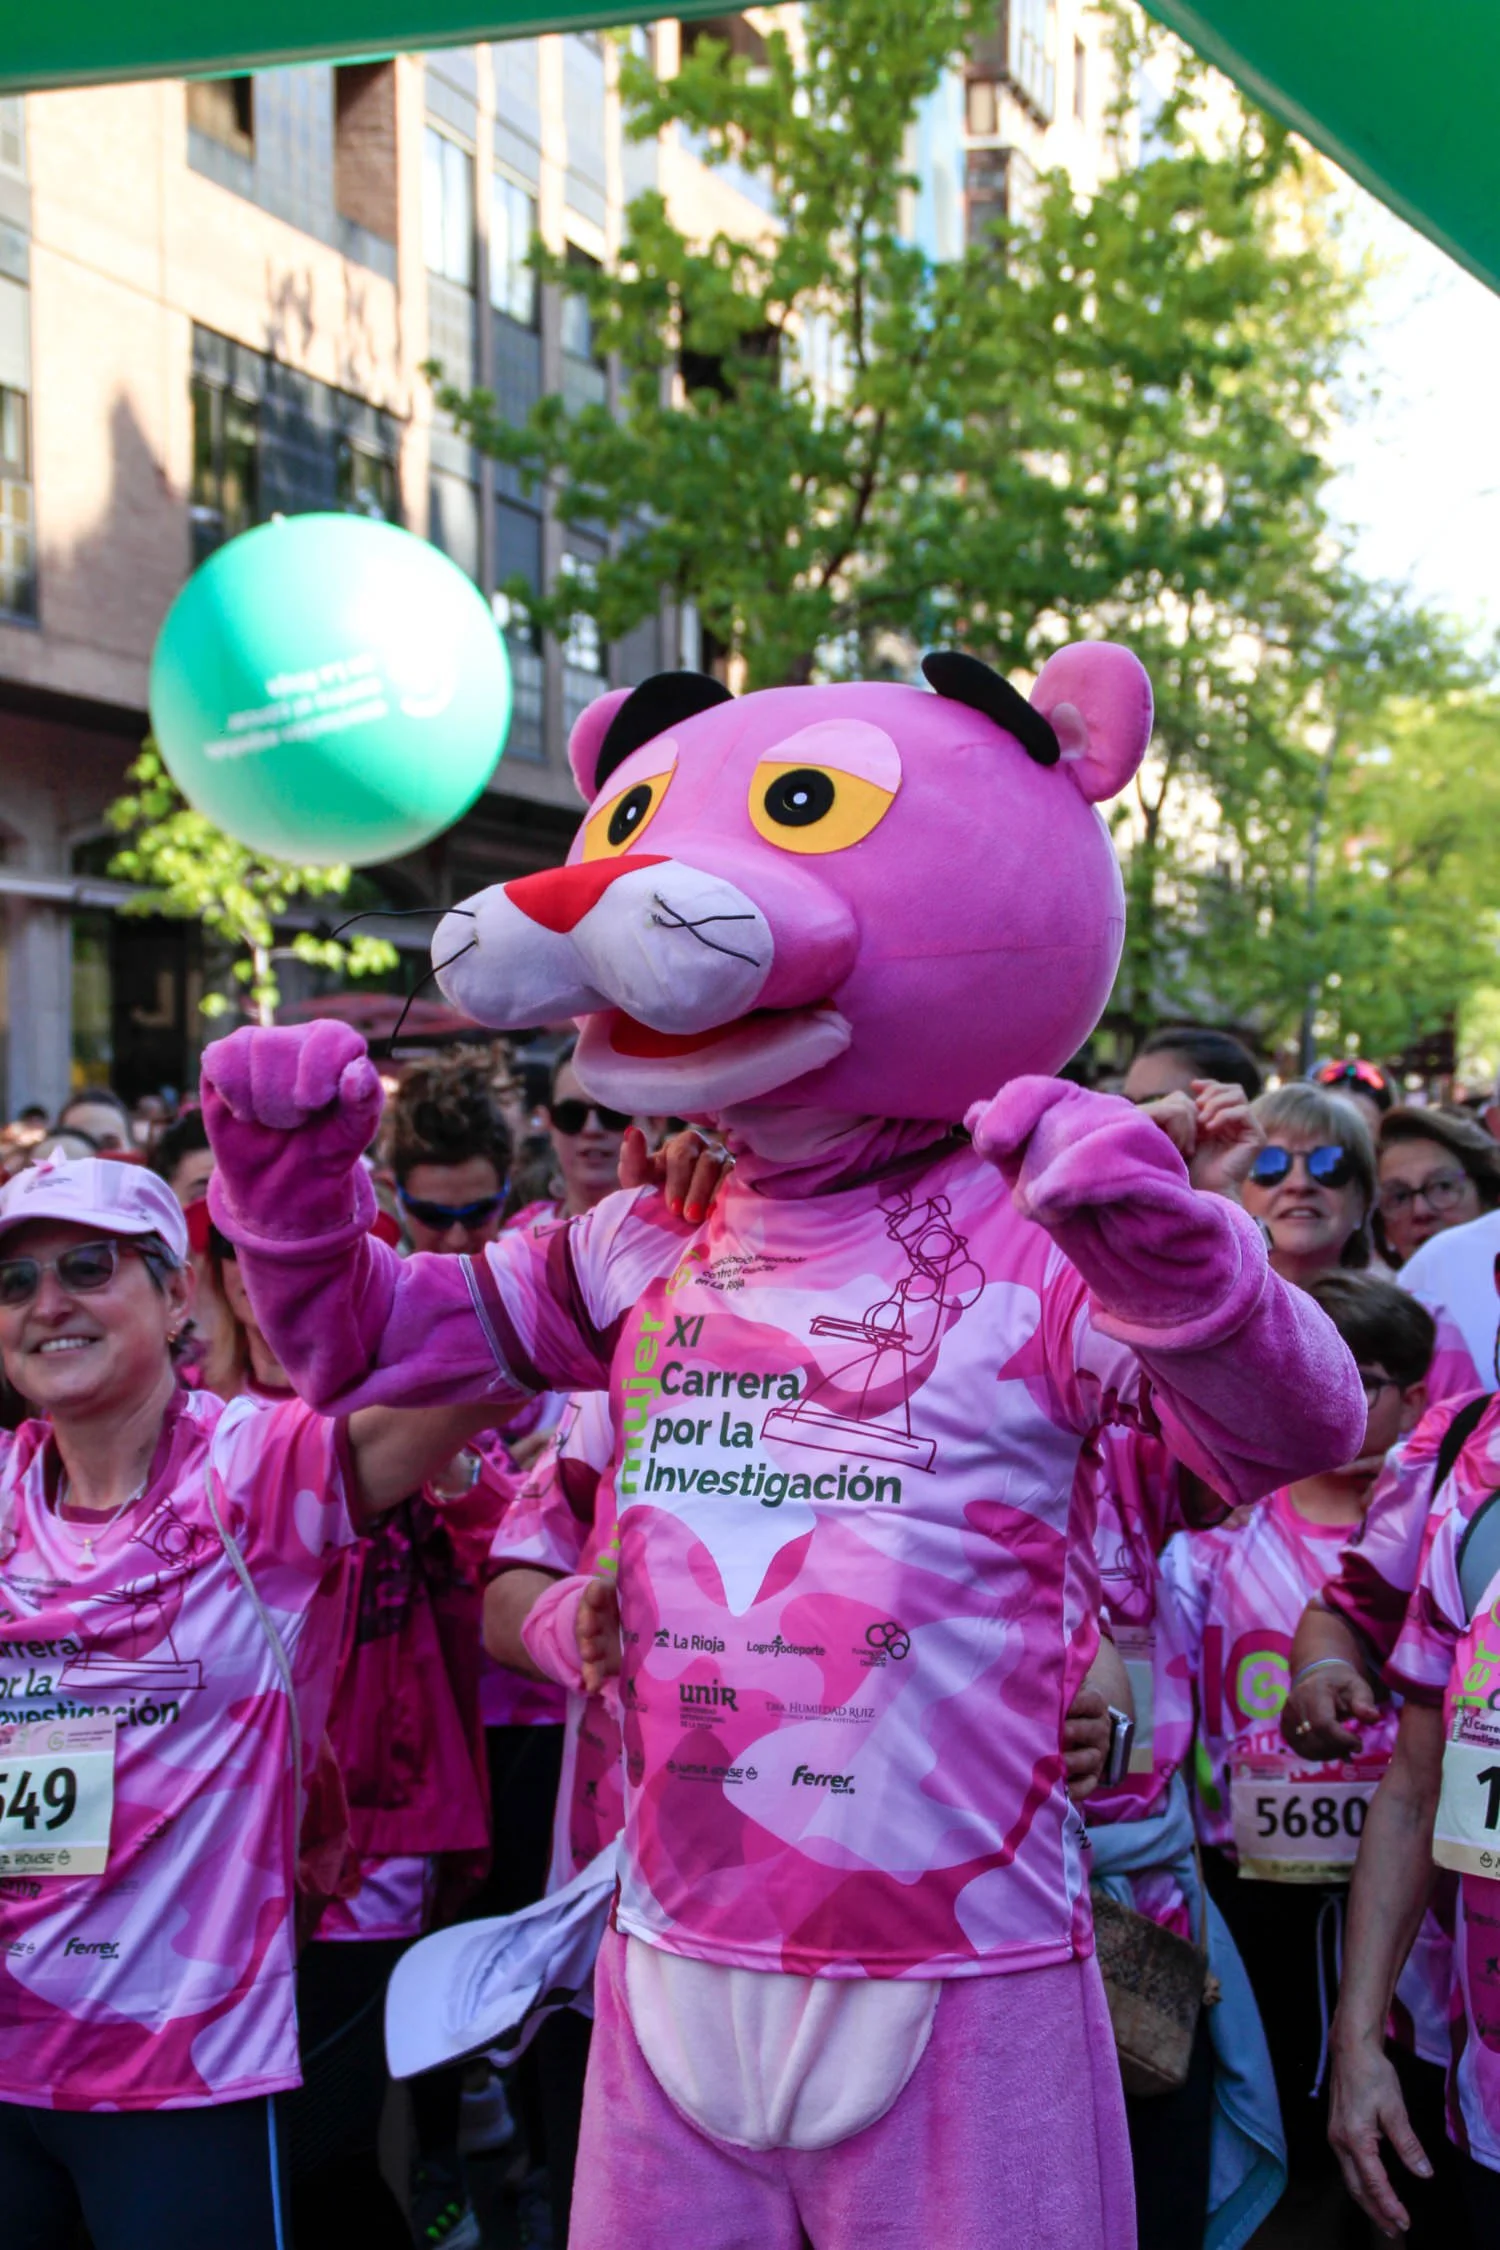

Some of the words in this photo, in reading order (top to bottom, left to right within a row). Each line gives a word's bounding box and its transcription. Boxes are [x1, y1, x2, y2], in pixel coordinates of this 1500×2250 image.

[666, 1315, 704, 1347] XI
[660, 1361, 799, 1401] Carrera
[622, 1312, 665, 1494] mujer
[650, 1416, 712, 1453] por
[719, 1412, 753, 1448] la
[644, 1458, 901, 1508] Investigación
[0, 1638, 83, 1659] rrera
[674, 1633, 688, 1649] La
[691, 1635, 726, 1654] Rioja
[25, 1668, 52, 1697] la
[849, 1707, 876, 1719] RUIZ
[0, 1767, 77, 1831] 49
[1256, 1796, 1370, 1838] 5680
